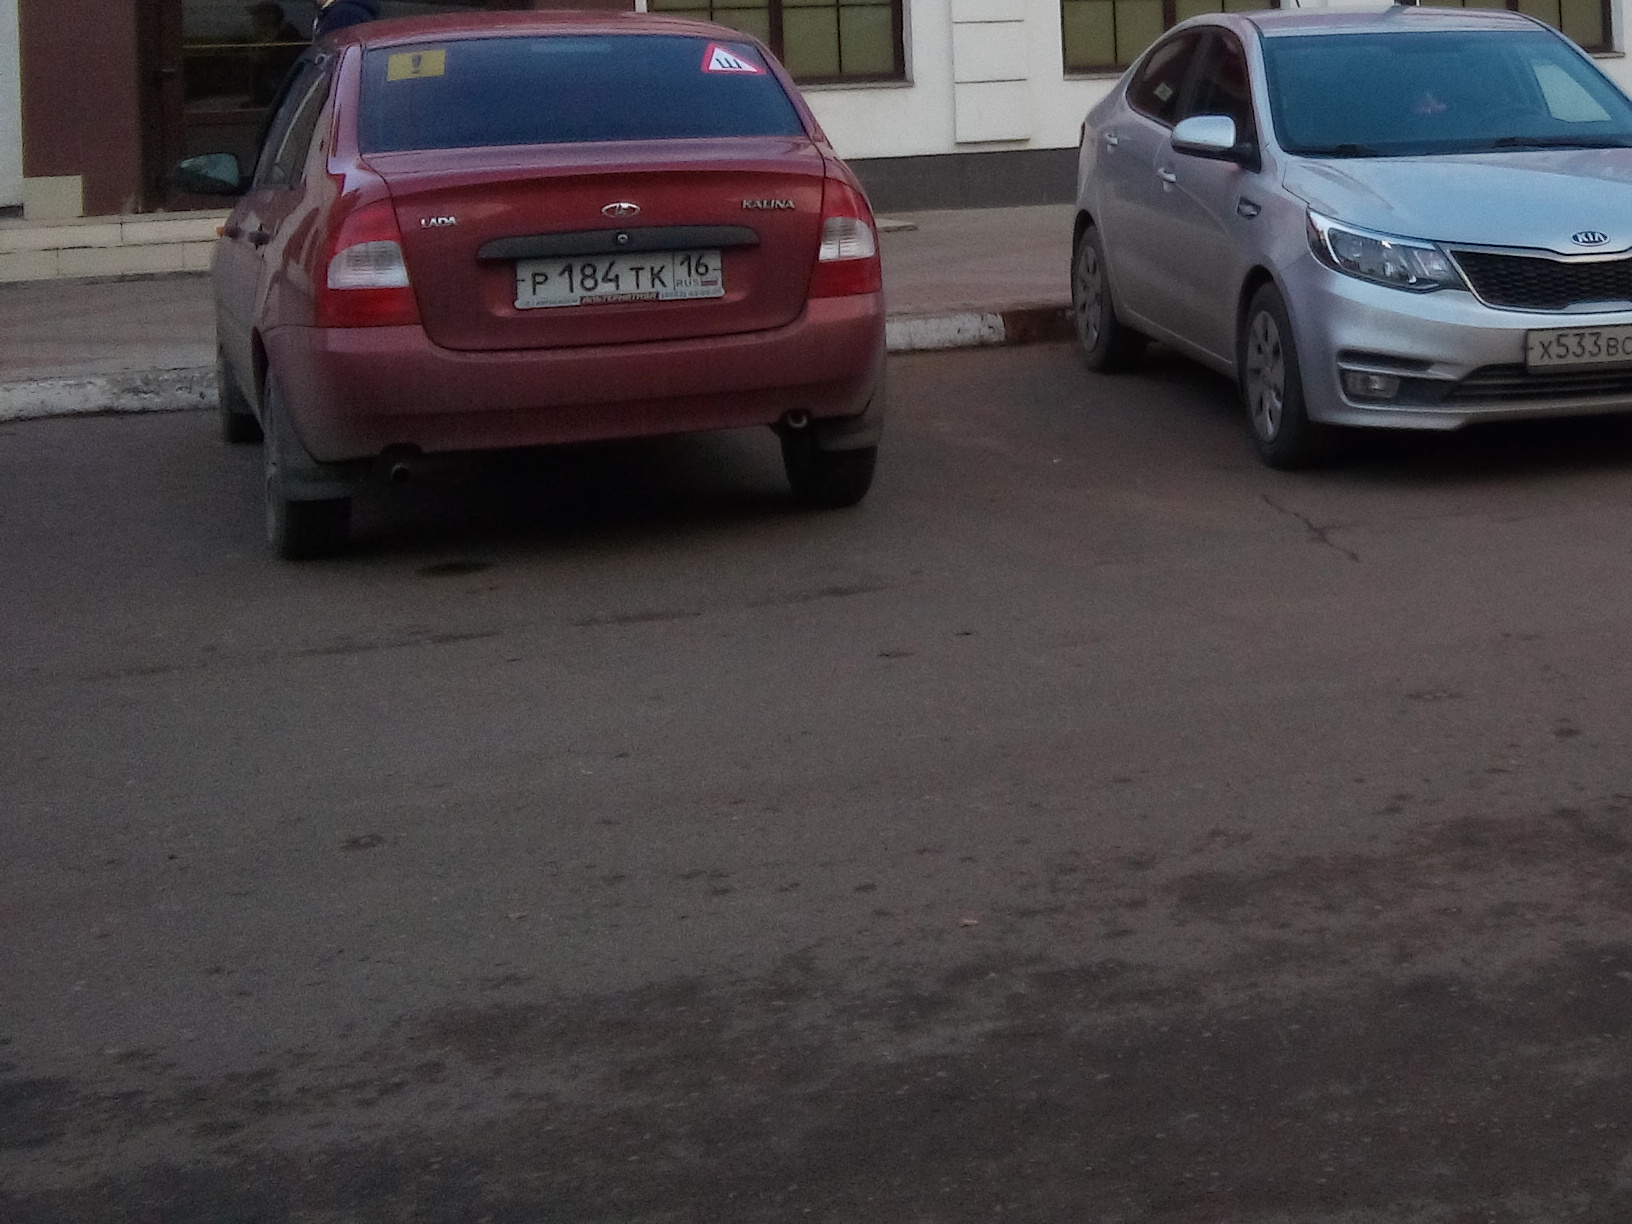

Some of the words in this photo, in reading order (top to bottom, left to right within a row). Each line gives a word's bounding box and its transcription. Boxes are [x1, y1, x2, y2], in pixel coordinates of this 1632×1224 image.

[742, 199, 796, 209] KALINA
[420, 216, 458, 227] LADA
[1576, 232, 1606, 244] KIA
